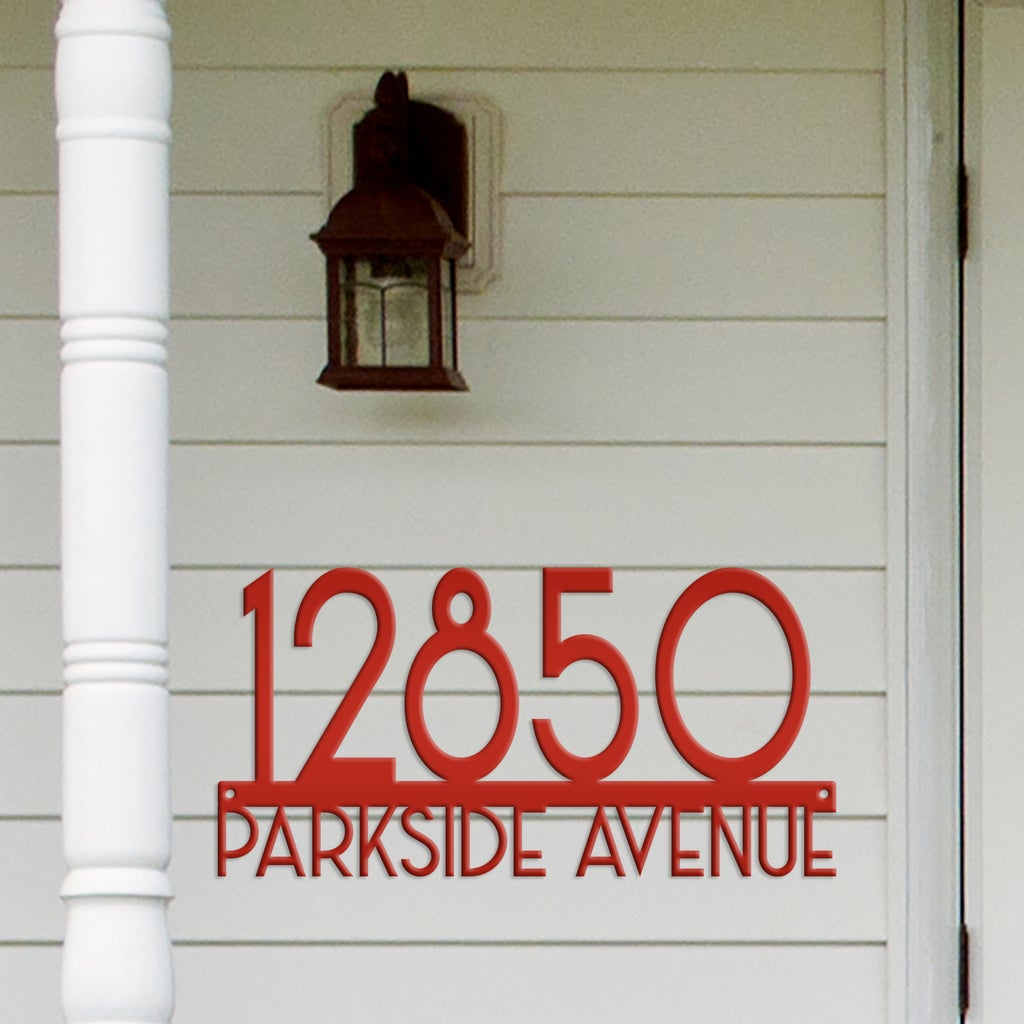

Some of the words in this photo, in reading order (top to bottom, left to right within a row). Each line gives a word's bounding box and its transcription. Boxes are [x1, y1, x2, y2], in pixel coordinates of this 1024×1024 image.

[243, 567, 811, 784] 12850
[218, 803, 546, 876] PARKSIDE
[576, 803, 836, 876] AVENUE
